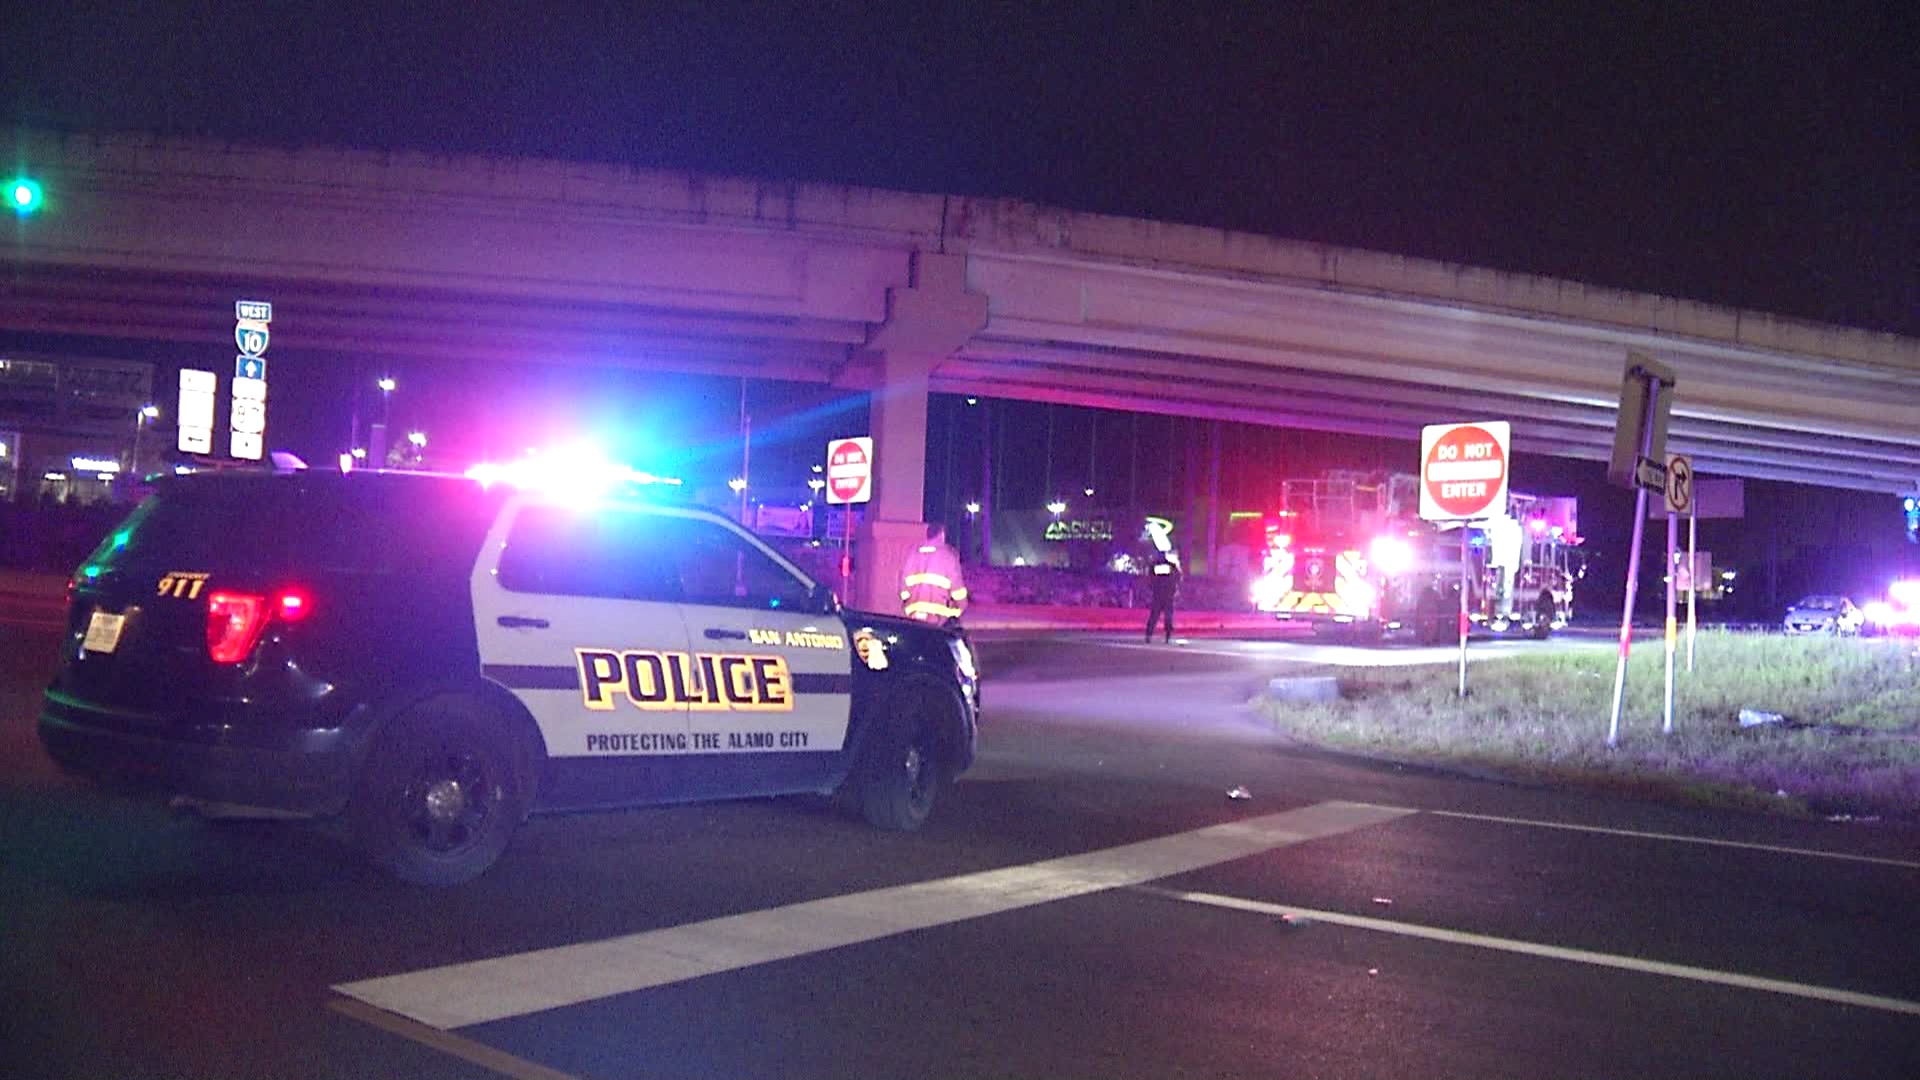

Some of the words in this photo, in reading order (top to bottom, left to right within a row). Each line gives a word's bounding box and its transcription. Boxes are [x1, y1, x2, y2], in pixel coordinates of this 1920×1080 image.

[241, 306, 266, 318] WEST
[244, 333, 261, 352] 10
[1438, 444, 1457, 459] DO
[1464, 443, 1493, 458] NOT
[1442, 482, 1486, 498] ENTER
[158, 577, 204, 599] 911
[748, 628, 781, 645] SAN
[785, 632, 843, 649] ANTONIO
[575, 648, 794, 711] POLICE
[587, 733, 687, 752] PROTECTING
[691, 733, 721, 749] THE
[727, 732, 774, 748] ALAMO
[780, 731, 809, 748] CITY
